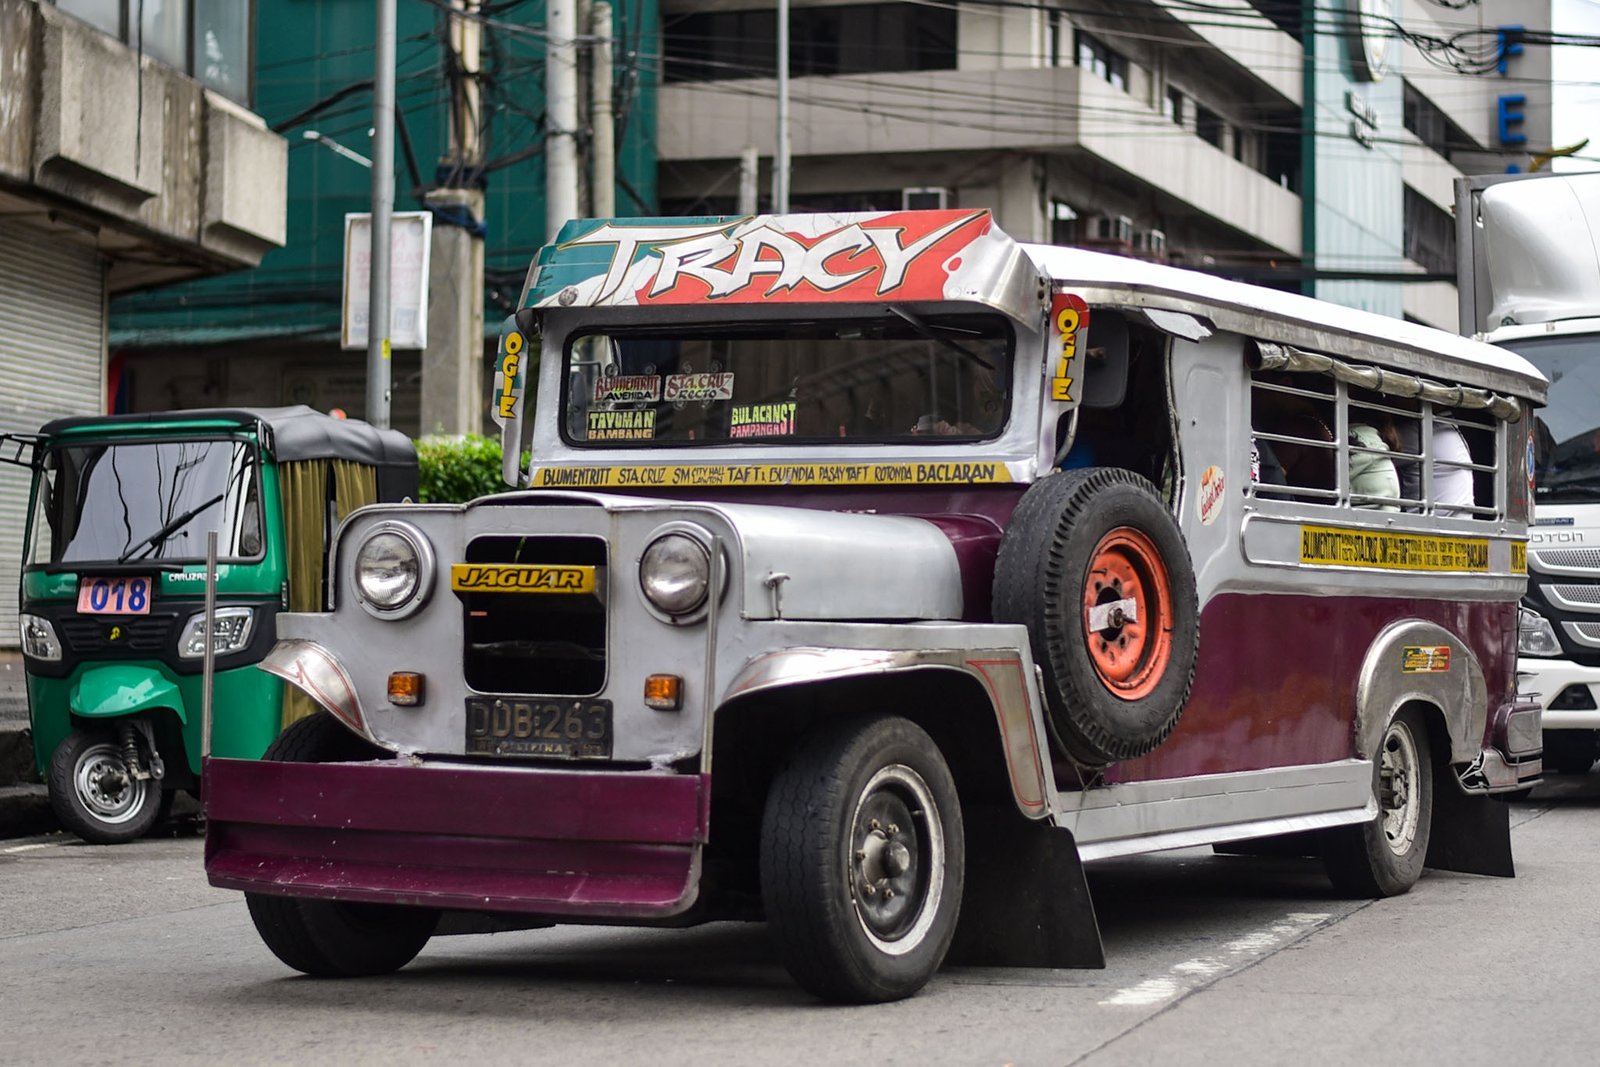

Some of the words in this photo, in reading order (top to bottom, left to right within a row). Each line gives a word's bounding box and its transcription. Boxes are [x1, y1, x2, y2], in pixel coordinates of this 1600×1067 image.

[558, 210, 988, 307] TRACY
[1051, 308, 1079, 401] OGIE
[499, 331, 524, 418] OGIE
[590, 412, 653, 429] TAYUMAN
[730, 423, 781, 437] PAMPANGA
[589, 429, 652, 438] BAMBANG
[543, 467, 611, 485] BLUMENTRITT
[673, 467, 690, 484] SM
[727, 467, 762, 483] TAFT
[819, 466, 845, 482] PASAY
[917, 464, 995, 482] BACLARAN
[459, 568, 583, 588] JAGUAR
[90, 579, 147, 612] 018
[542, 704, 607, 740] 263
